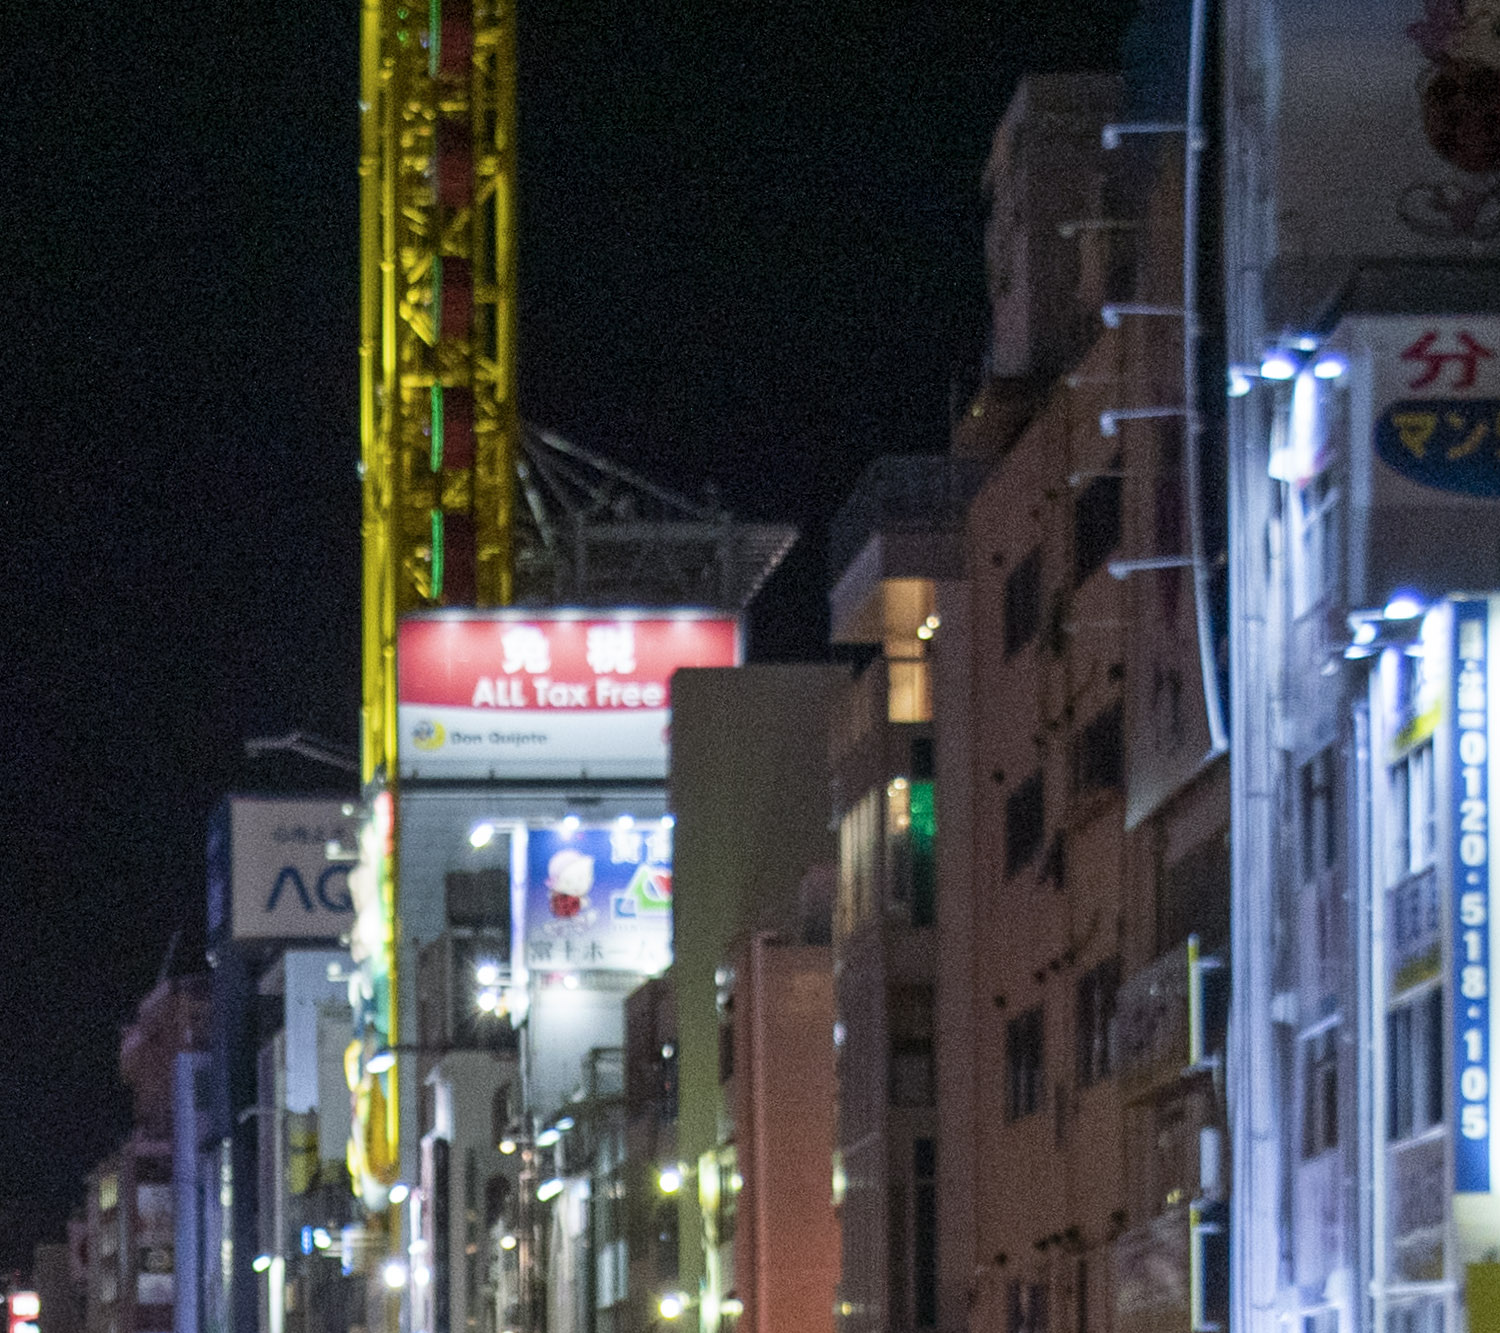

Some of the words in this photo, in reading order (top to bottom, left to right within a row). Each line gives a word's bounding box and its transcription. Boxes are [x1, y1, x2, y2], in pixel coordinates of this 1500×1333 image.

[473, 676, 524, 707] ALL
[532, 677, 587, 707] Tax
[596, 678, 664, 707] Free
[451, 731, 482, 744] Don
[489, 731, 548, 748] Quijote
